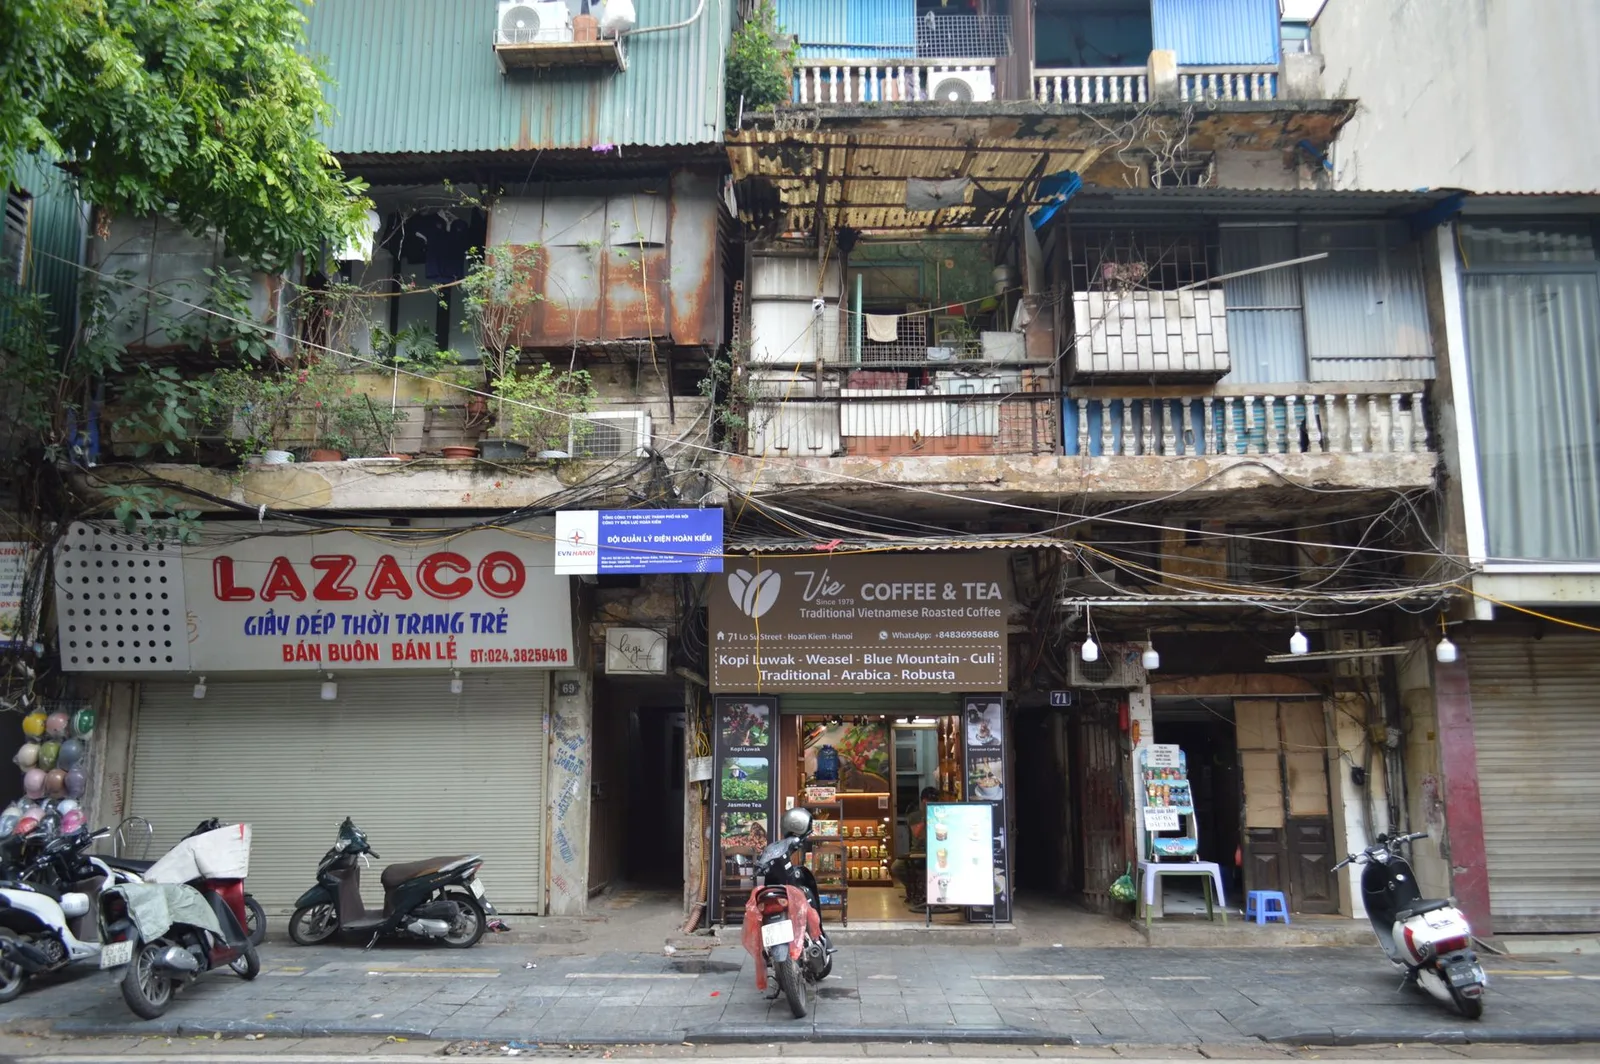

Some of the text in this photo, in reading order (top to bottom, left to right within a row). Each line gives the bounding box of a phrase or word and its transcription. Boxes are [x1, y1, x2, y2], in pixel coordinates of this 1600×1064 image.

[608, 535, 620, 544] ĐỘI
[654, 534, 671, 543] ĐIỆN
[673, 534, 693, 542] HOÀN
[213, 551, 526, 602] LAZACO
[794, 568, 1002, 602] Vie COFFEE & TEA
[800, 606, 1002, 619] Traditional Vietnamese Roasted Coffee
[296, 609, 336, 636] DÉP
[341, 609, 390, 636] THỜI
[395, 611, 465, 635] TRANG
[469, 606, 509, 634] TRẺ
[728, 633, 738, 642] 71
[831, 632, 853, 640] Hanoi
[892, 632, 932, 640] WhatsApp:
[282, 635, 568, 663] BÁN BUÔN BÁN LẺ ĐT:024.38259418
[719, 652, 995, 668] Kopi Luwak Weasel Blue Mountain Culi
[760, 669, 955, 681] Traditional Arabica Robusta
[562, 683, 575, 694] 69
[1054, 693, 1067, 704] 71
